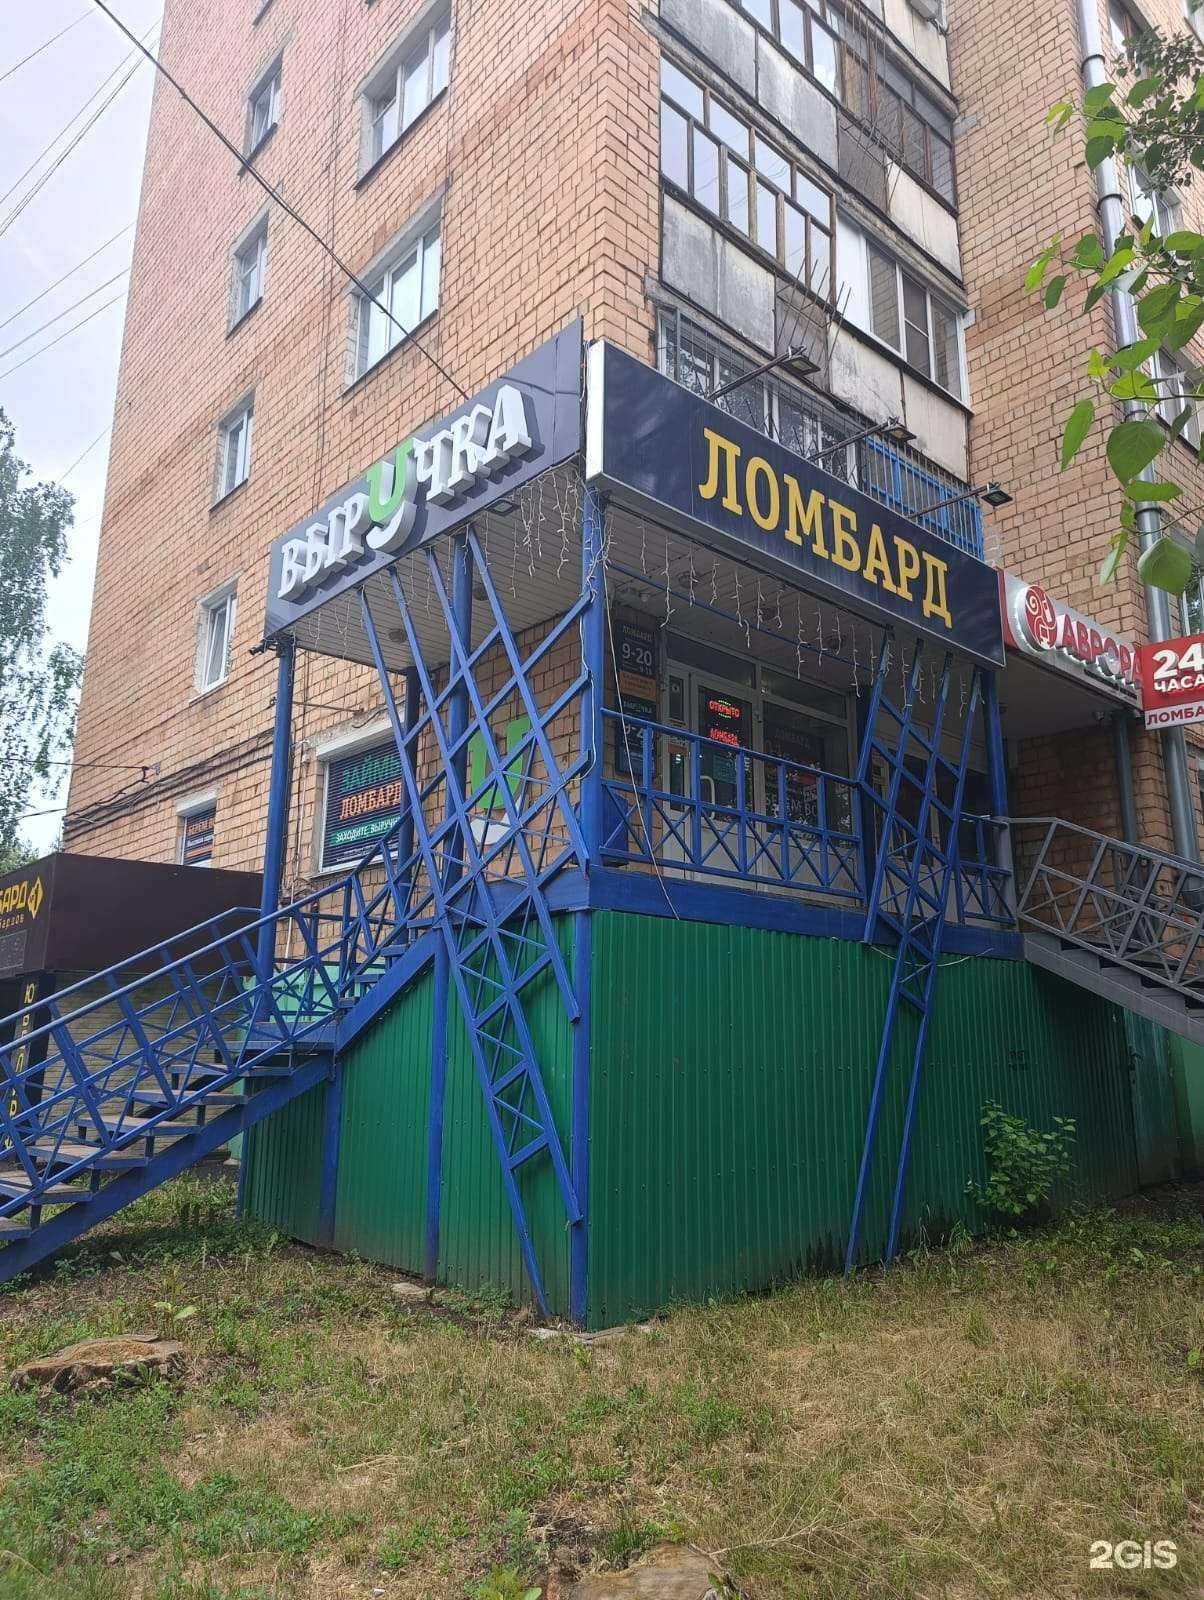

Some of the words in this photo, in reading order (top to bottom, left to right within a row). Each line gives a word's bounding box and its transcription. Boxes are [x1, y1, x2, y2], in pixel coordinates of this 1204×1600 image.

[698, 427, 953, 629] ЛОМБАРД
[622, 643, 652, 667] 9-20
[1152, 642, 1204, 680] 24
[709, 700, 740, 718] ОТКРЫТО
